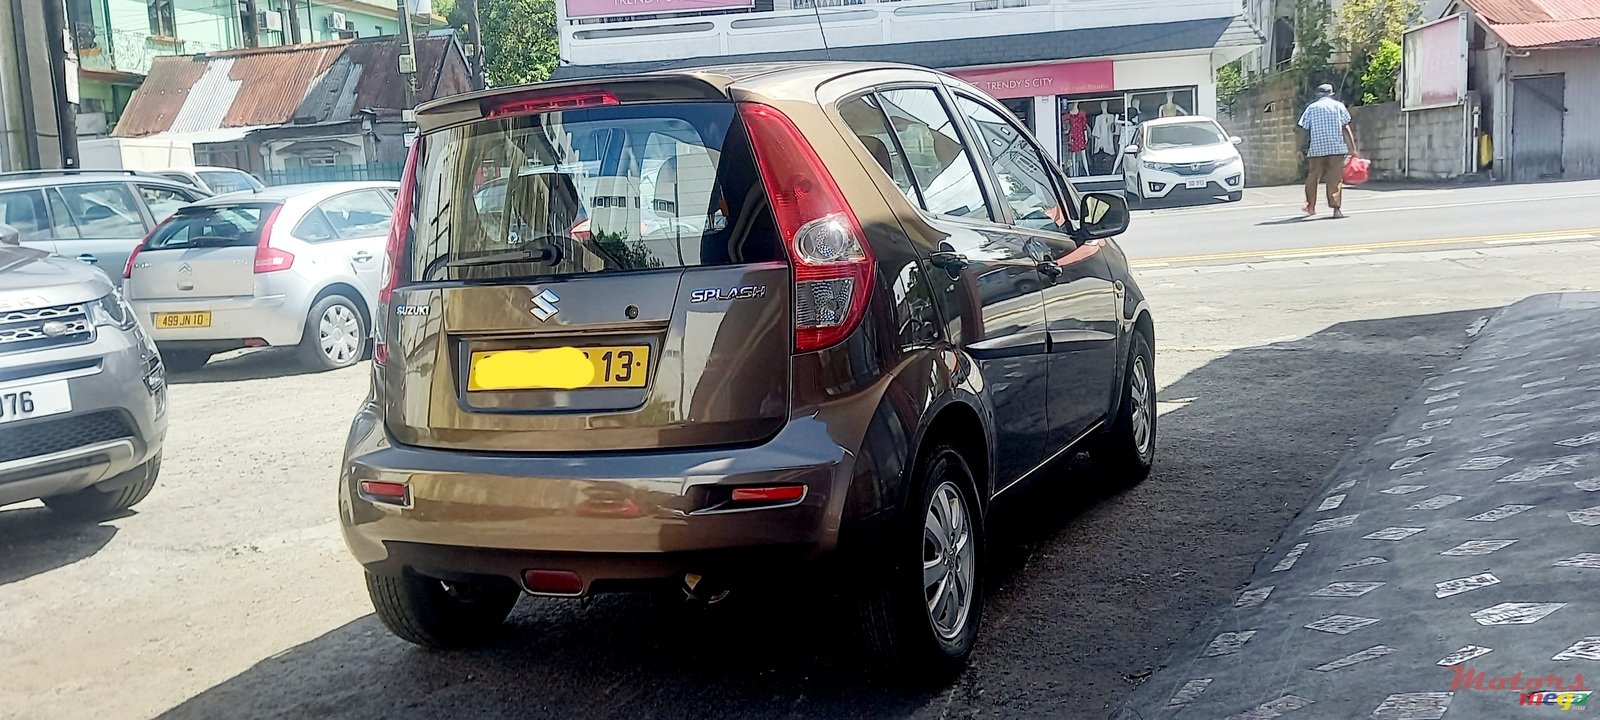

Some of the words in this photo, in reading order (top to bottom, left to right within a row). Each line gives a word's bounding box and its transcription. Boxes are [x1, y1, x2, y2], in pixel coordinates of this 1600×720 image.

[986, 78, 1030, 90] TRENDY'S
[1032, 77, 1054, 88] CITY
[690, 285, 767, 303] SPLASH
[396, 304, 431, 316] SUZUKI
[162, 315, 179, 327] 499
[180, 315, 191, 326] JN
[193, 314, 204, 325] 10
[601, 351, 634, 383] 13
[0, 391, 35, 417] 76
